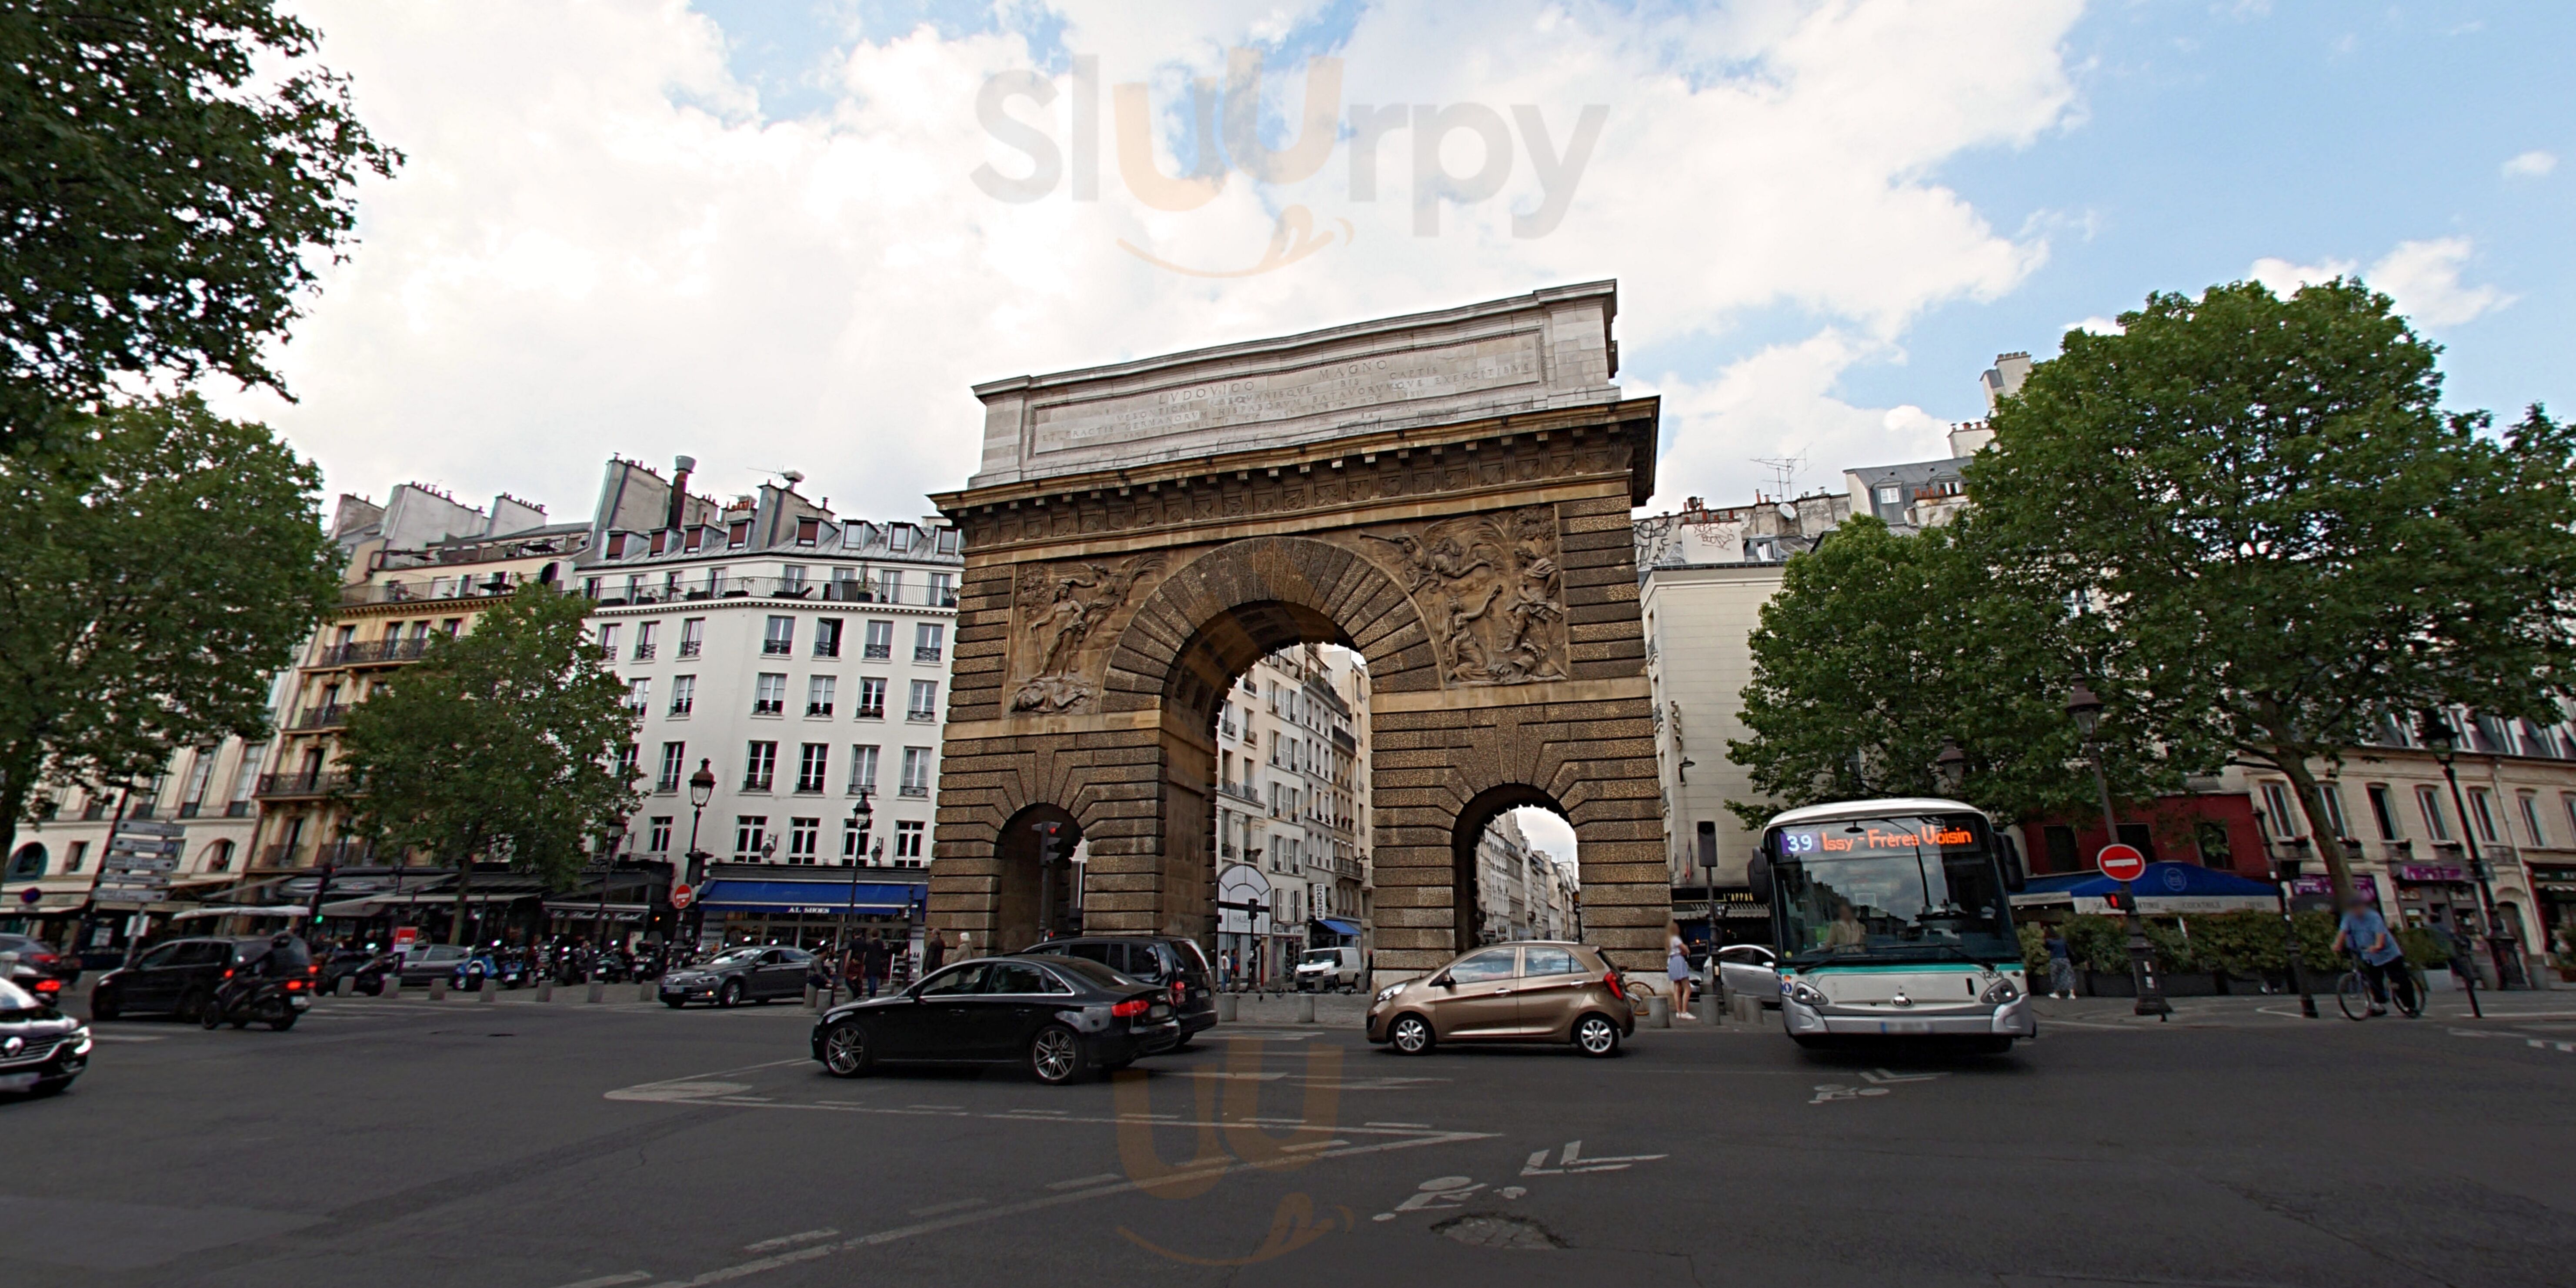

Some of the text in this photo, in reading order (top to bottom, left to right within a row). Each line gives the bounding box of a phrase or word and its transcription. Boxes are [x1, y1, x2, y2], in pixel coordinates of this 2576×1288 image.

[1158, 381, 1254, 404] LVDOVICO
[1340, 378, 1359, 387] BIS
[1787, 834, 1812, 851] 39
[1822, 832, 1853, 852] Issy
[1868, 828, 1919, 848] Frères
[1921, 824, 1972, 846] Voisin
